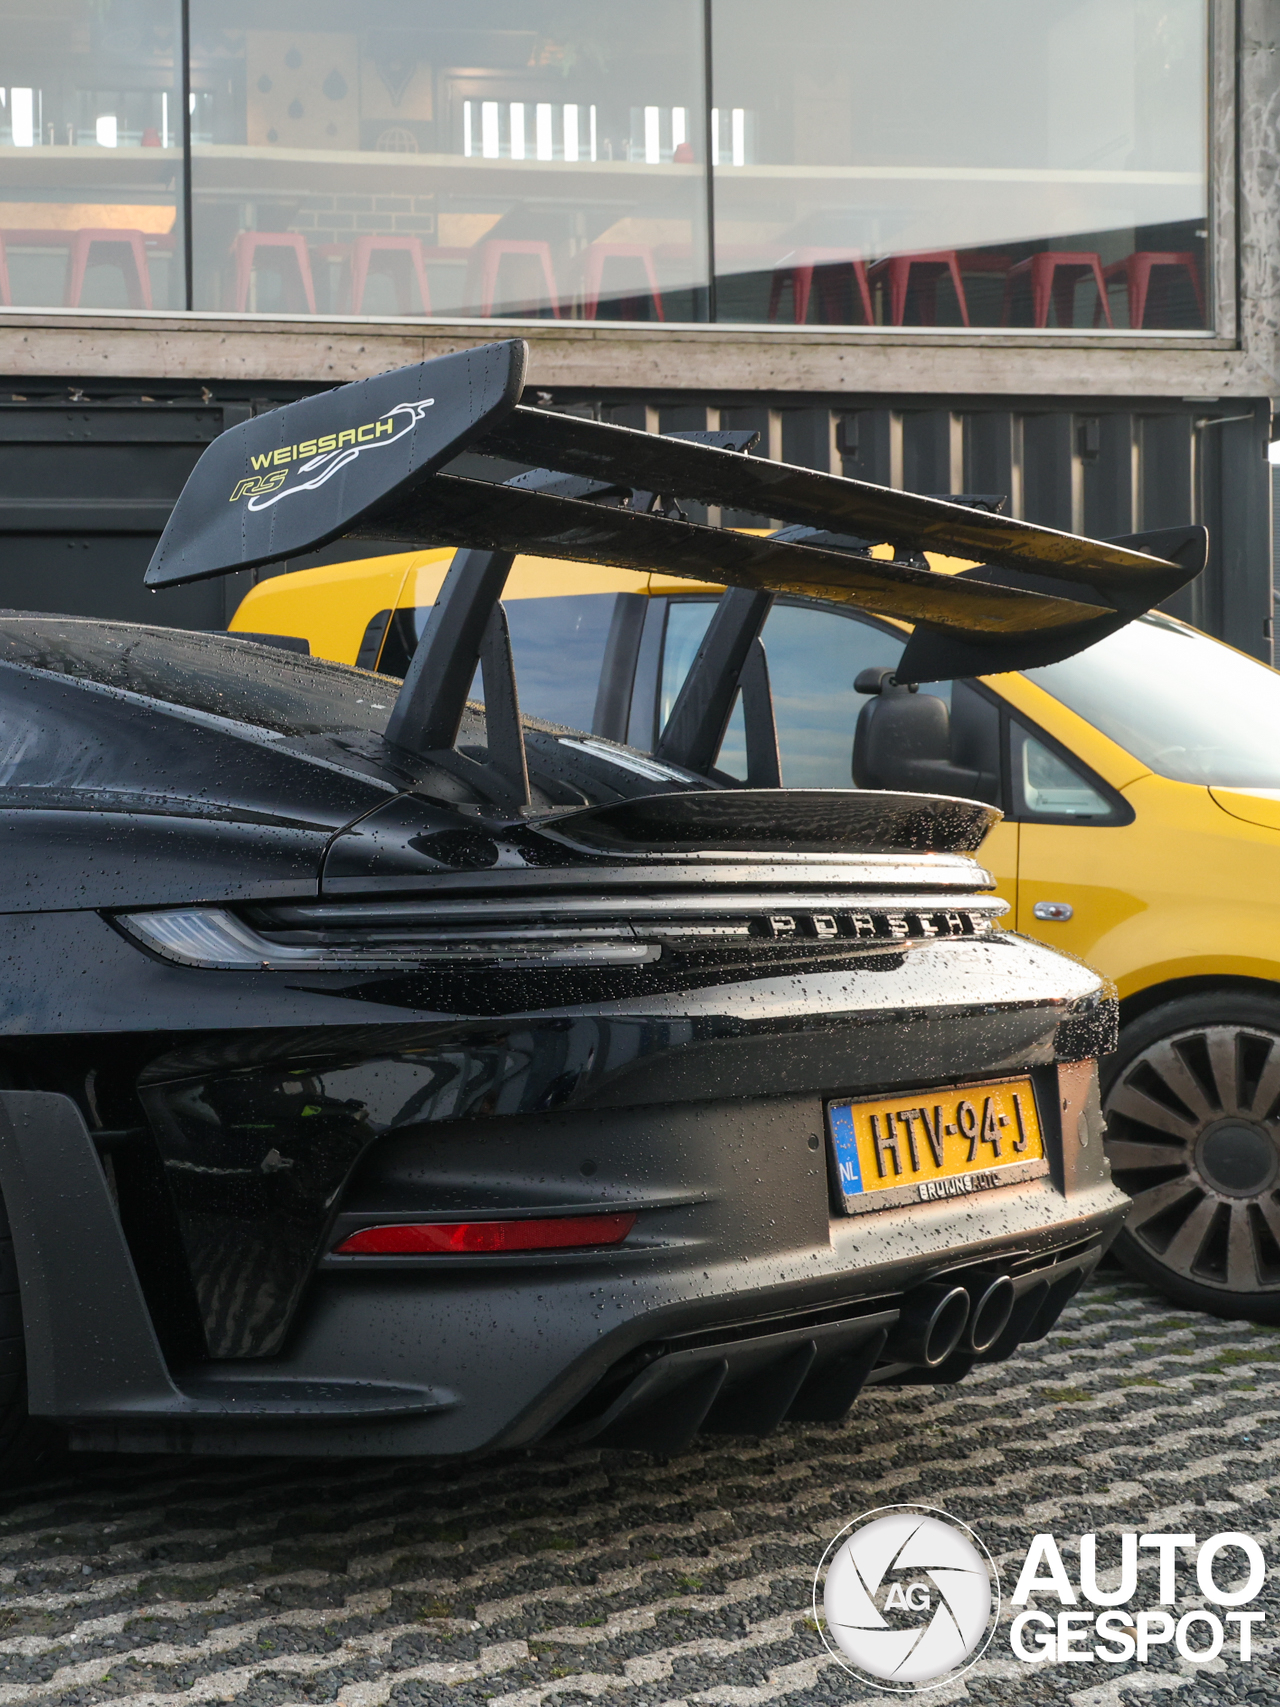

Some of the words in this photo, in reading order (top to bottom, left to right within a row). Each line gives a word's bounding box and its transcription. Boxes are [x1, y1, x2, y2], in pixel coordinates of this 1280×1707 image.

[251, 418, 393, 471] WEISSACH
[229, 469, 288, 502] RS
[770, 912, 991, 938] PORSCHE
[839, 1162, 858, 1182] NL
[870, 1093, 1028, 1178] HTV-94-J
